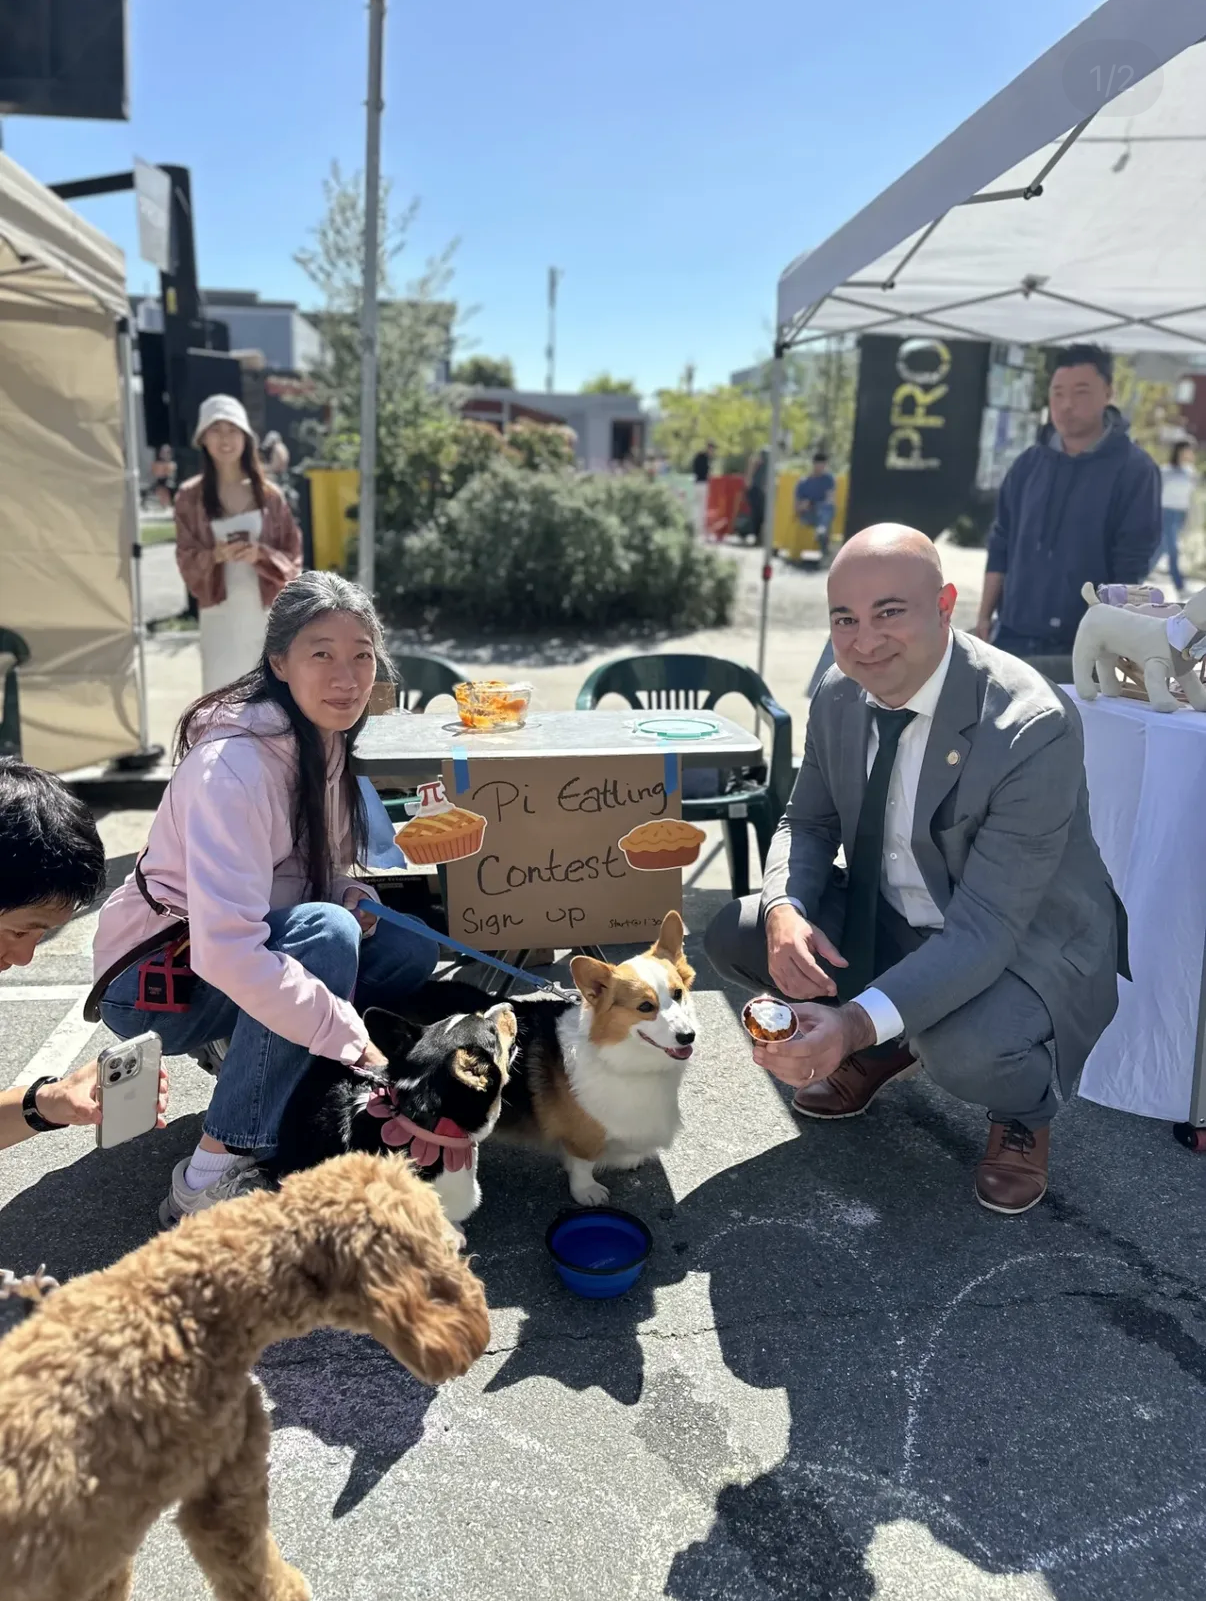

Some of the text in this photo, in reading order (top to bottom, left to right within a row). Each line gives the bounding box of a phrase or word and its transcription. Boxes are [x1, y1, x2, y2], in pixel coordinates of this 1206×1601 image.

[885, 337, 951, 470] PRO
[472, 780, 535, 822] Pi
[477, 846, 626, 895] Contest
[463, 907, 523, 935] Sign
